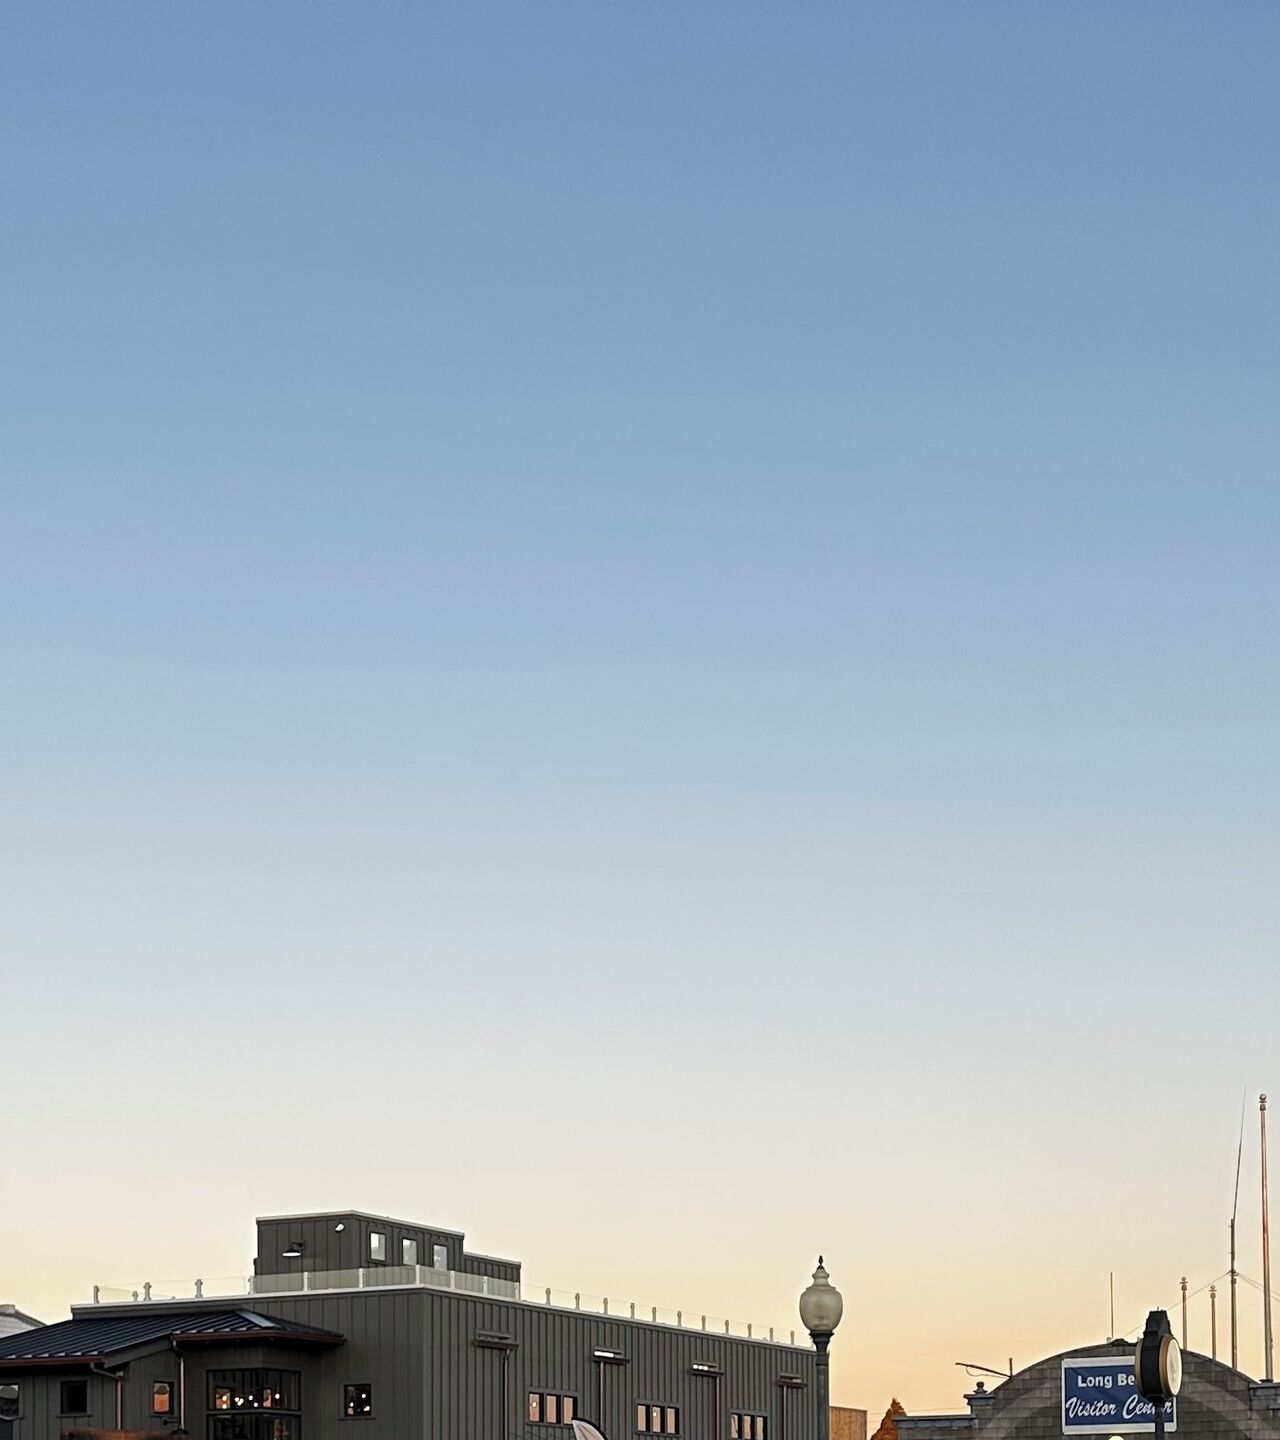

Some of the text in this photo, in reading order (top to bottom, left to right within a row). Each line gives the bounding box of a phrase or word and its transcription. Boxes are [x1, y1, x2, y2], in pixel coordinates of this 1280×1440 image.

[1077, 1373, 1135, 1388] Long Be
[1065, 1394, 1173, 1420] Visitor Cenr
